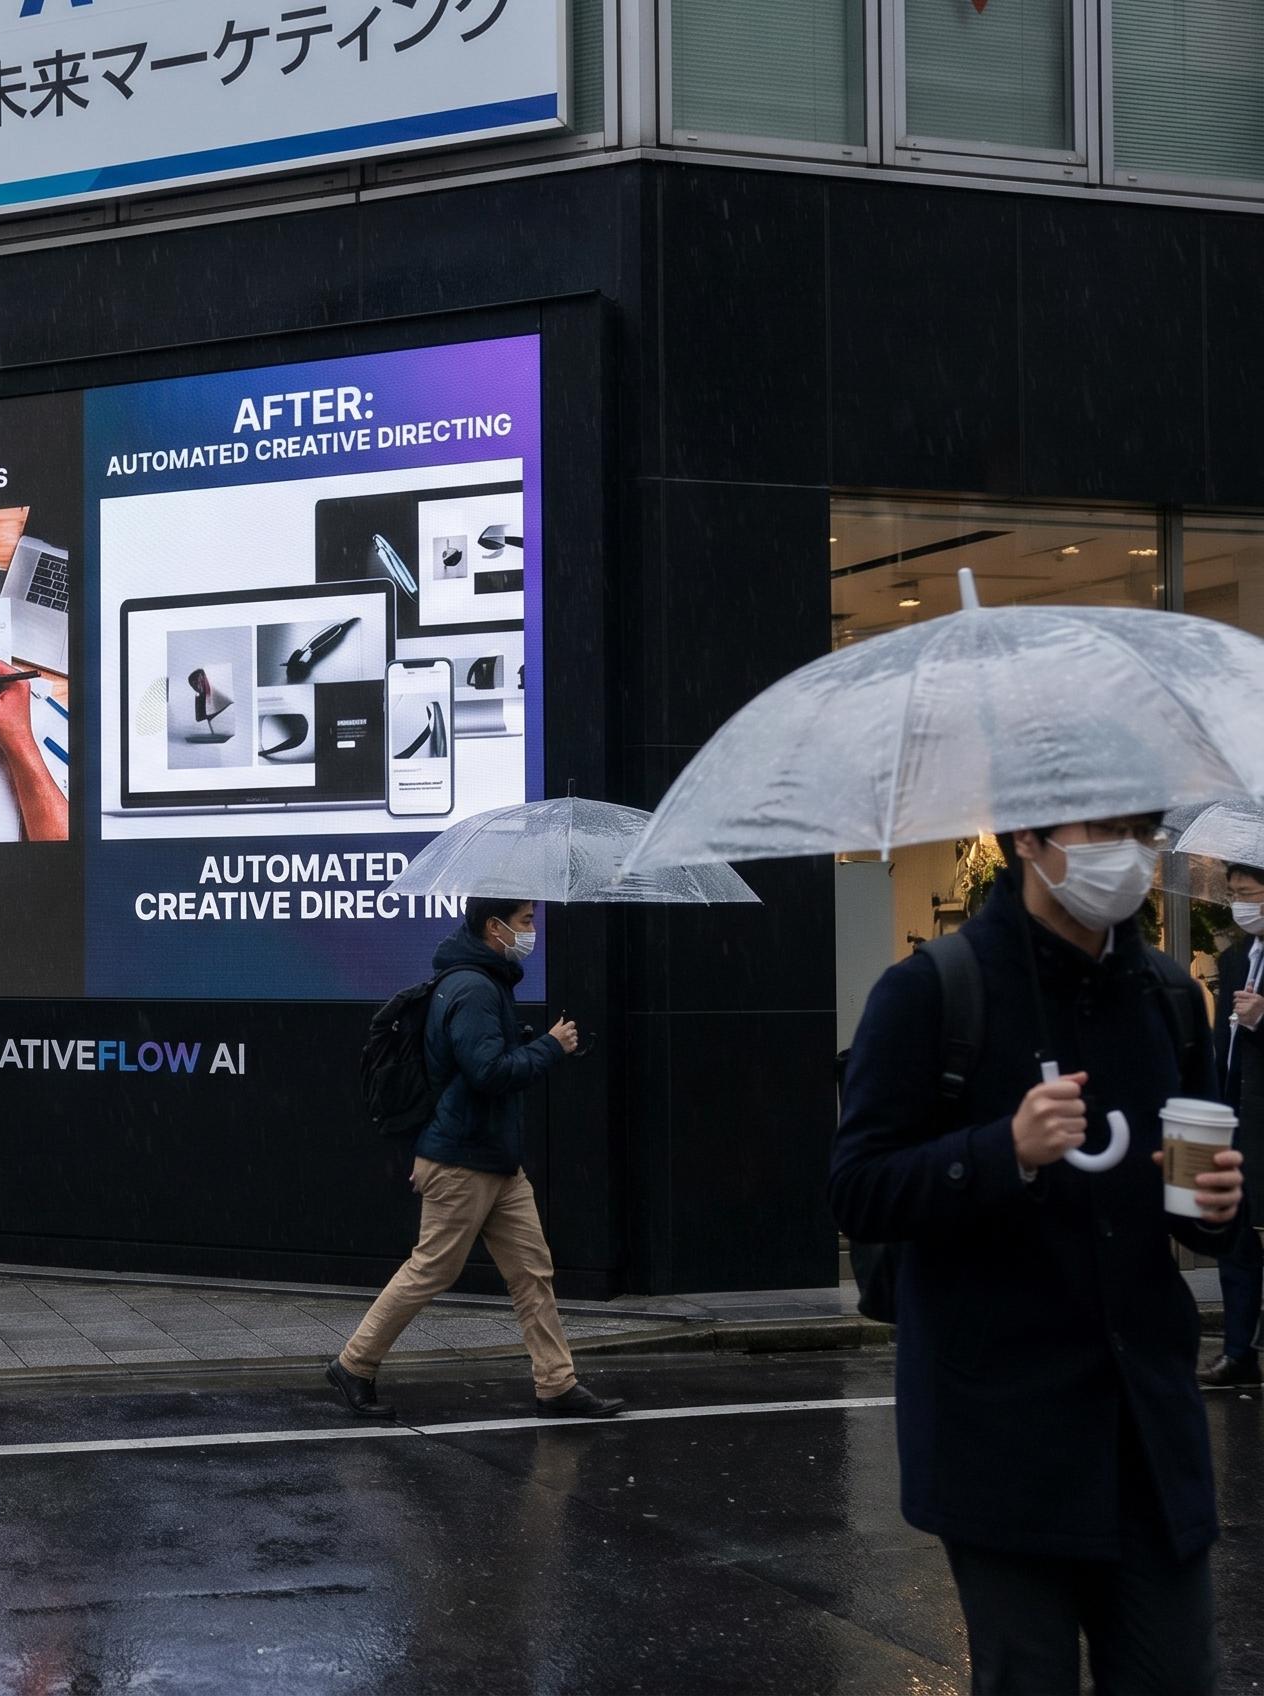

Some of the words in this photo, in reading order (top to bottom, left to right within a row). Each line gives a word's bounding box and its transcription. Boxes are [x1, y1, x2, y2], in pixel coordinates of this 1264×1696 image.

[232, 386, 374, 434] AFTER:
[106, 442, 249, 477] AUTOMATED
[255, 428, 371, 461] CREATIVE
[377, 412, 512, 449] DIRECTING
[199, 852, 410, 884] AUTOMATED
[135, 891, 291, 921] CREATIVE
[208, 1042, 246, 1075] AI
